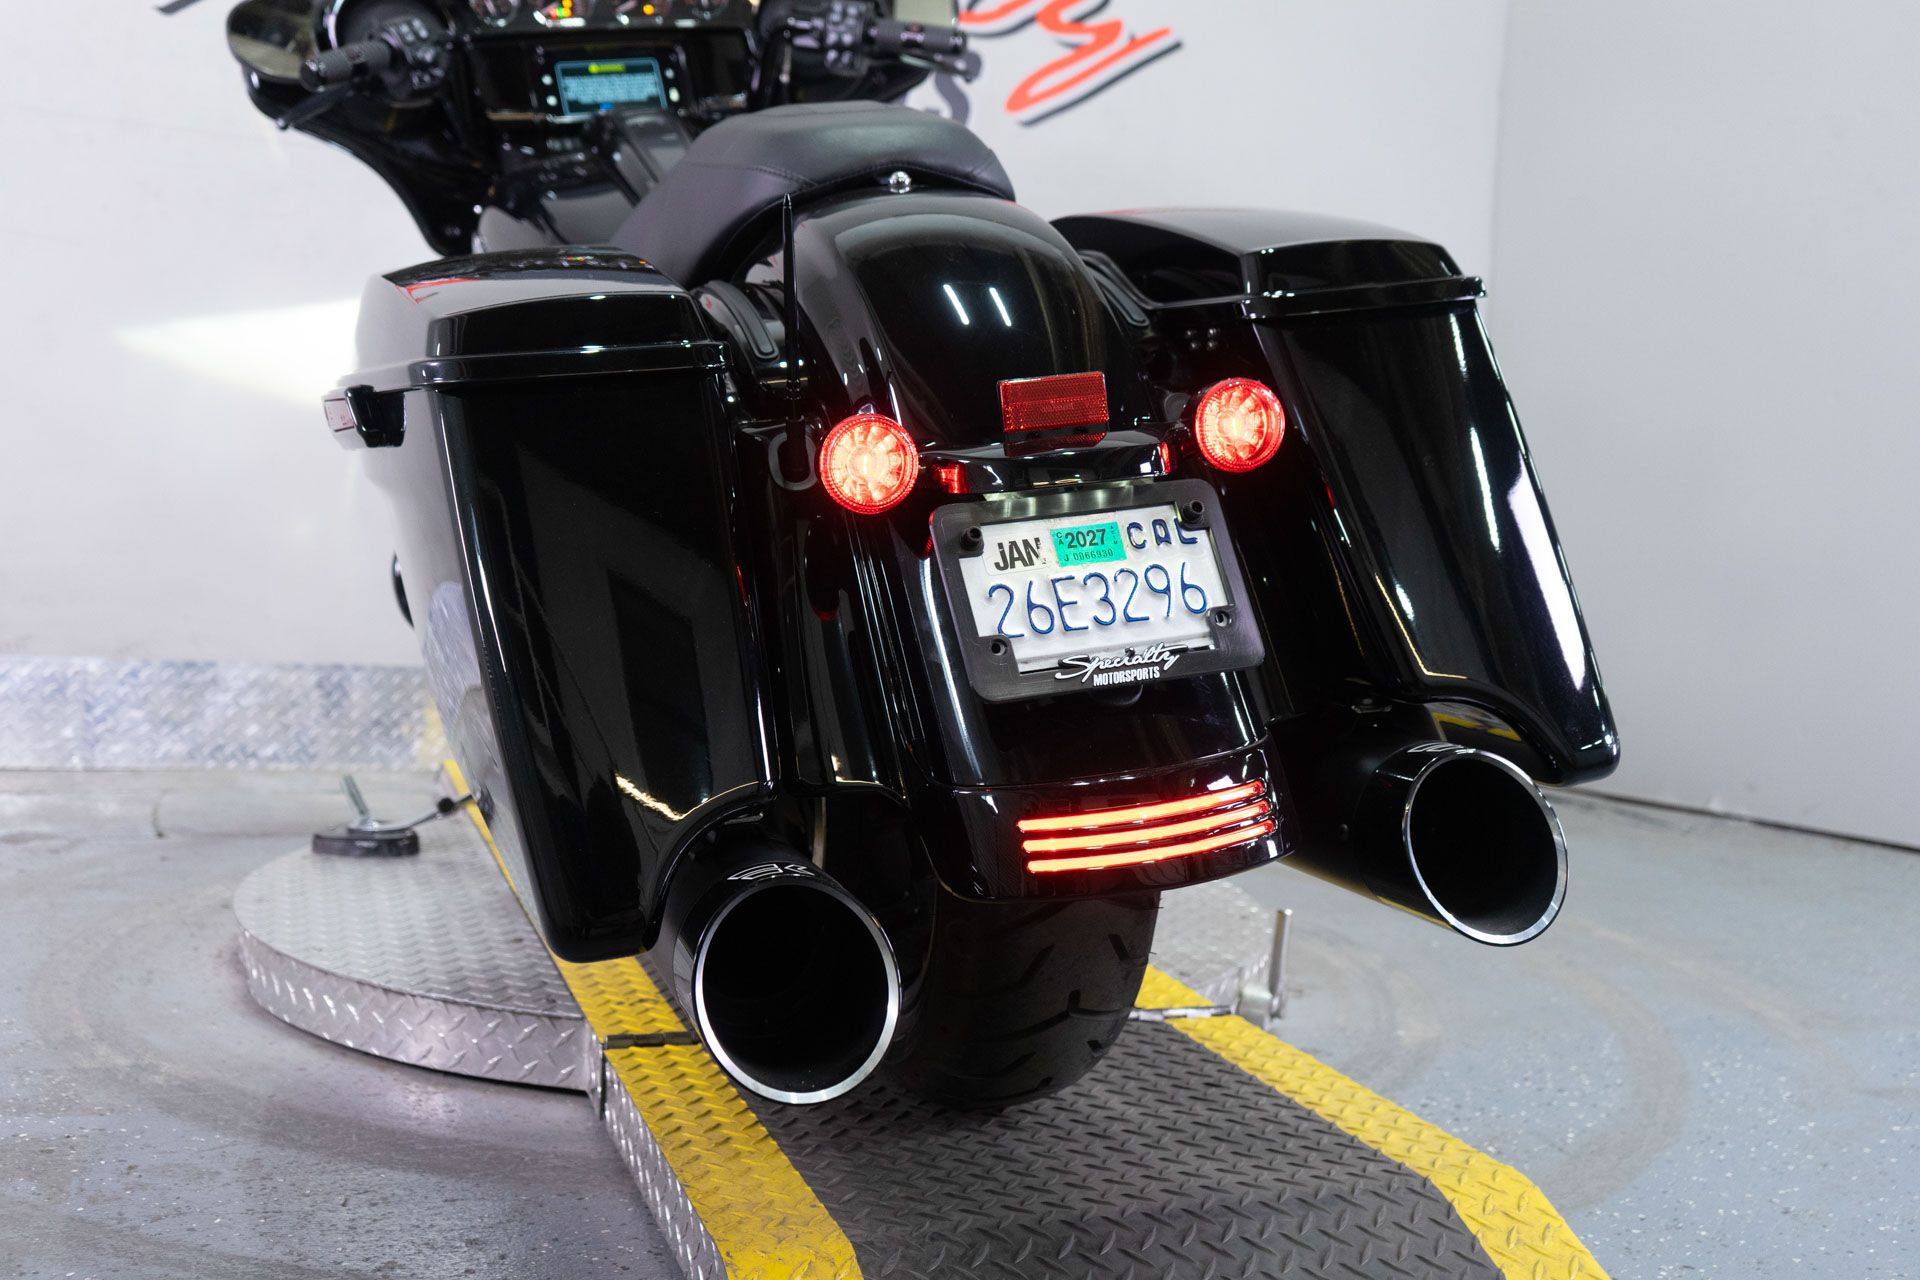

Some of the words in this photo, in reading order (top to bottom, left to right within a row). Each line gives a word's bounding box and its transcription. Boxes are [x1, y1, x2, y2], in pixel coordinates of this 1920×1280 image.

[994, 537, 1041, 571] JAN
[1065, 528, 1106, 549] 2027
[988, 562, 1208, 639] 26E3296
[1055, 642, 1188, 683] Specialty
[1093, 665, 1160, 687] MOTORSPORTS
